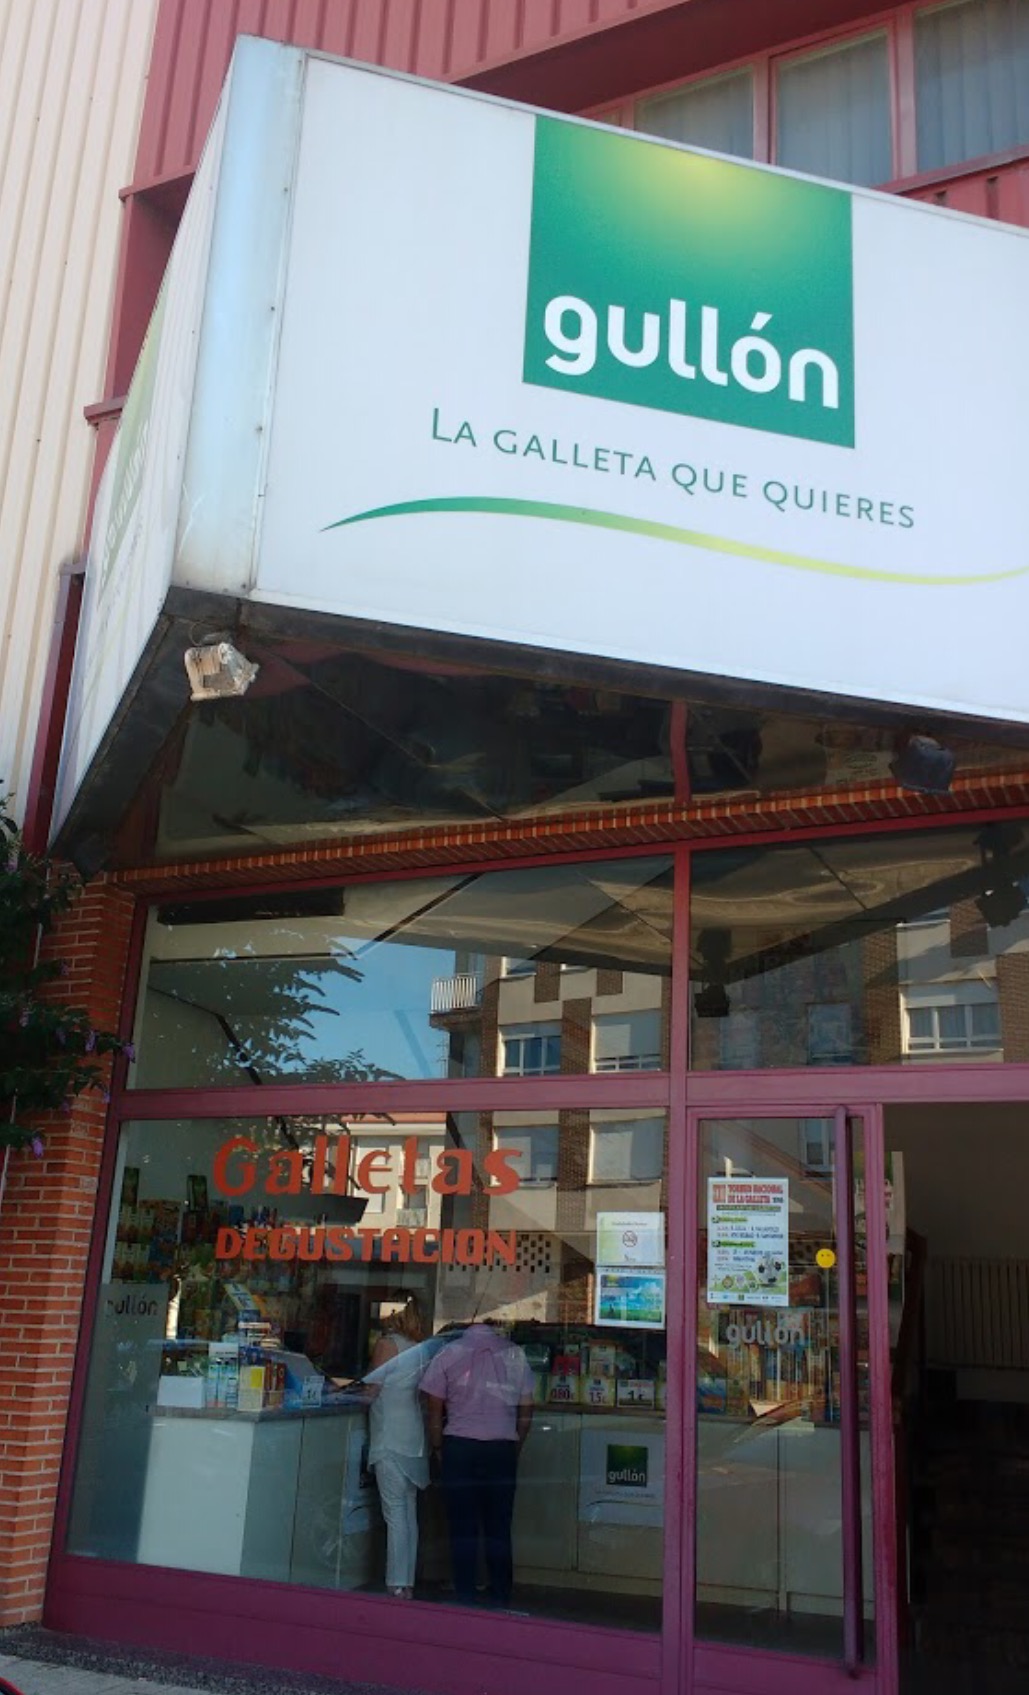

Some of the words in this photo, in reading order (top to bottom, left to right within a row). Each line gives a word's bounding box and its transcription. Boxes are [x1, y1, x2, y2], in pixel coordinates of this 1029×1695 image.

[543, 294, 840, 410] gullón
[431, 407, 477, 447] LA
[492, 428, 657, 482] GALLETA
[671, 461, 749, 499] QUE
[762, 479, 916, 529] QUIERES
[213, 1134, 524, 1197] Galletas
[215, 1227, 517, 1265] DEGUSTACION
[608, 1468, 646, 1484] gullón
